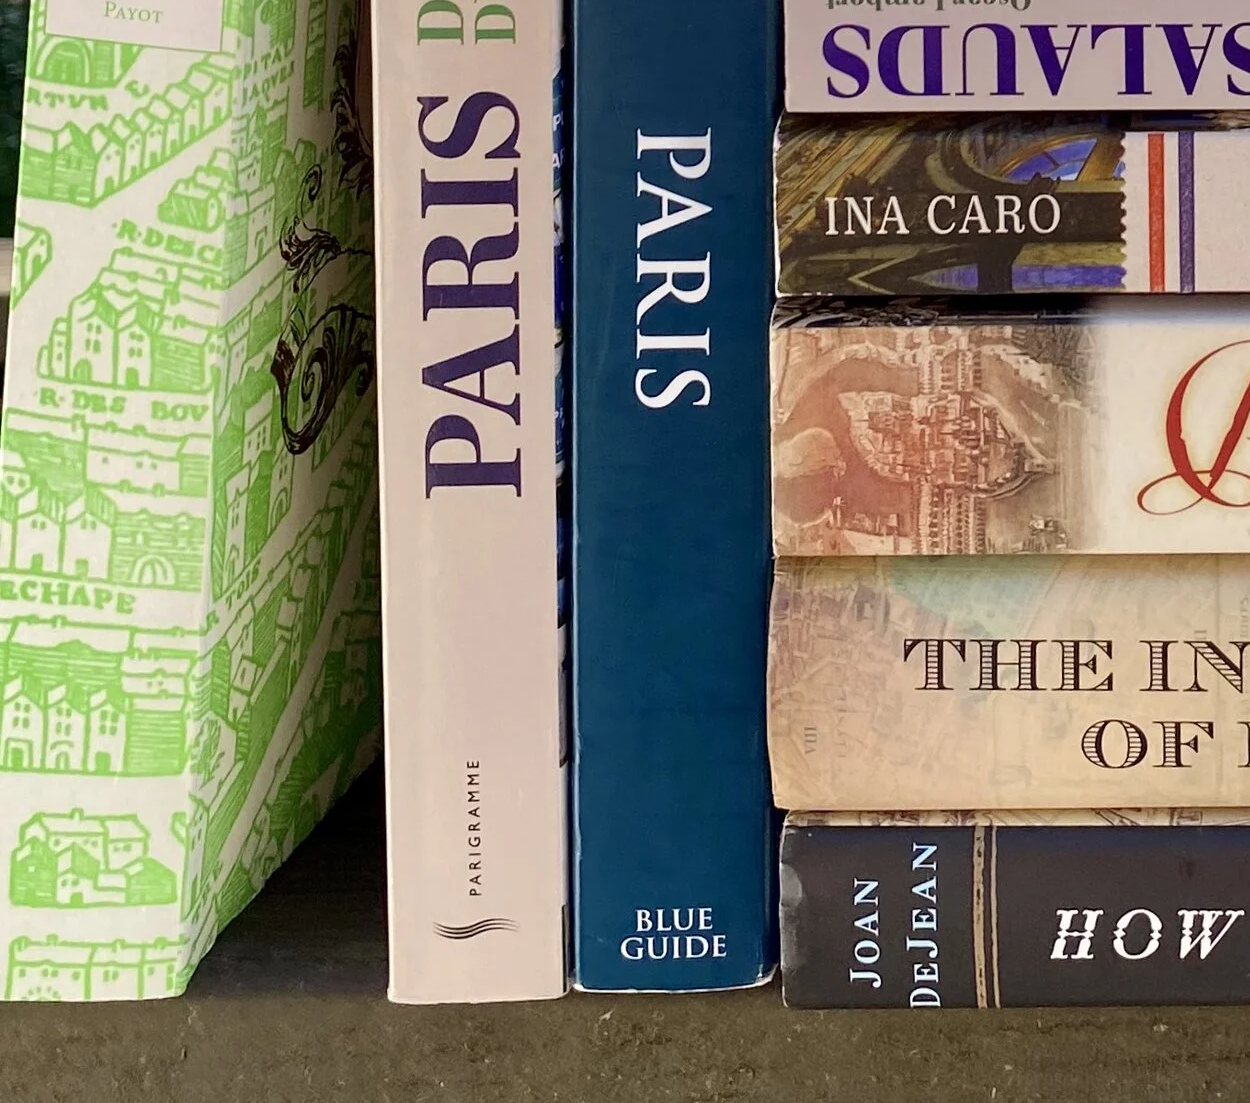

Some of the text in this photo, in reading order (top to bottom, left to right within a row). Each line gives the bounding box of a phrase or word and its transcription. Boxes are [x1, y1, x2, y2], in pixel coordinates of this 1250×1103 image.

[104, 1, 163, 24] PAYOT
[824, 194, 1062, 236] INA CARO
[634, 127, 713, 409] PARIS
[417, 91, 522, 499] PARIS
[904, 638, 1114, 692] THE
[1081, 719, 1215, 770] OF
[466, 759, 482, 897] PARIGRAMME
[635, 907, 713, 932] BLUE
[849, 877, 882, 989] JOAN
[1049, 908, 1245, 960] HOW
[620, 934, 728, 961] GUIDE
